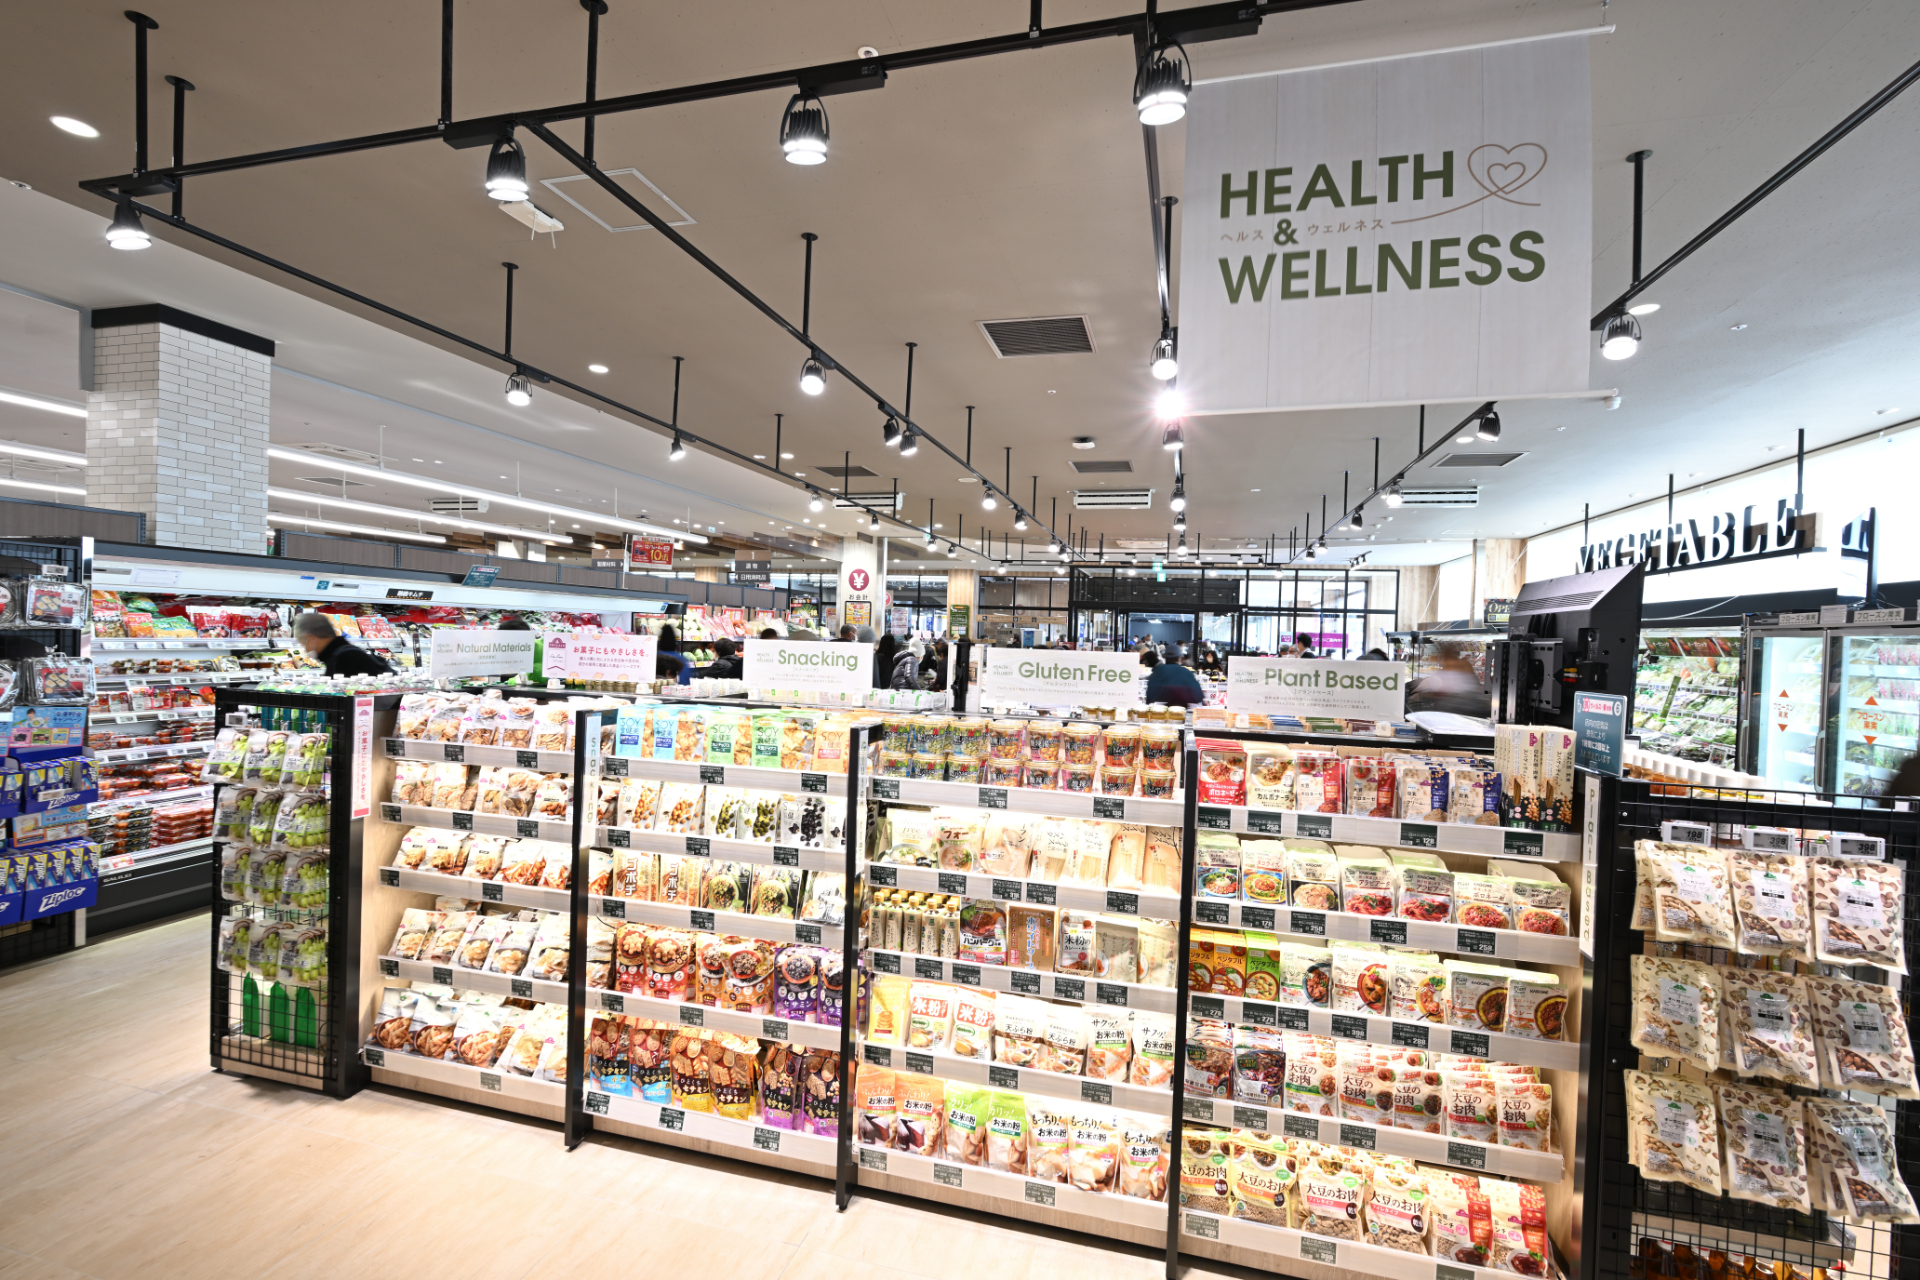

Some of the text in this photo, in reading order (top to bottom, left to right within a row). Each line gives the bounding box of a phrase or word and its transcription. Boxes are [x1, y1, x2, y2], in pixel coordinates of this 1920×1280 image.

[1220, 150, 1454, 219] HEALTH
[1220, 218, 1385, 246] ヘルス & ウェルネス
[1218, 230, 1546, 305] WELLNESS
[1857, 609, 1903, 619] フローズン果実
[456, 642, 532, 653] Natural Materials
[573, 646, 649, 657] お菓子にもやさしさを。
[778, 649, 858, 672] Snacking
[1018, 661, 1132, 683] Gluten Free
[1265, 667, 1399, 691] Plant Based
[1857, 711, 1885, 722] フローズン
[712, 724, 734, 734] SOY
[1863, 720, 1878, 730] 果実
[757, 727, 779, 737] SOY
[822, 732, 844, 742] SOY
[586, 737, 597, 824] Snacking
[1208, 788, 1235, 797] ボロネーゼ
[47, 793, 81, 810] Ziploc
[943, 830, 970, 839] フォー
[1686, 830, 1702, 839] 198
[1769, 837, 1787, 845] 398
[1858, 843, 1876, 852] 398
[1583, 788, 1596, 942] Plant Based
[1416, 885, 1451, 893] アラビアータ
[38, 886, 86, 913] Ziploc
[1473, 892, 1505, 900] ボロネーゼ
[1716, 929, 1729, 938] 150g
[1026, 915, 1036, 970] ホワイトソース
[1064, 935, 1090, 946] 米粉の
[1217, 955, 1243, 964] ベジタブル
[1250, 960, 1276, 969] ベジタブル
[649, 979, 676, 990] セサミン
[783, 1000, 812, 1009] セサミン
[913, 997, 940, 1016] 米粉
[958, 1004, 988, 1026] 米粉
[1757, 1008, 1783, 1016] オーガニック
[1005, 1024, 1034, 1035] 天ぷら粉
[1096, 1030, 1125, 1039] お米の粉
[1048, 1033, 1076, 1047] 天ぷら粉
[1144, 1040, 1173, 1051] お米の粉
[1694, 1052, 1708, 1061] 150g
[1288, 1063, 1317, 1075] 大豆の
[1288, 1073, 1311, 1086] お肉
[1343, 1075, 1374, 1089] 大豆の
[682, 1085, 709, 1094] セサミン
[716, 1087, 738, 1096] ひとくち
[898, 1090, 930, 1100] ふんわり!
[1343, 1086, 1367, 1099] お肉
[718, 1094, 746, 1104] セサミン
[868, 1096, 895, 1105] お米の粉
[1452, 1093, 1482, 1105] 大豆の
[904, 1099, 933, 1111] お米の粉
[1452, 1103, 1476, 1117] お肉
[1502, 1100, 1531, 1111] 大豆の
[950, 1109, 976, 1125] お米の粉
[1032, 1113, 1062, 1126] もっちり!
[1503, 1110, 1527, 1123] お肉
[992, 1117, 1021, 1131] お米の粉
[1070, 1115, 1102, 1130] もっちり!
[1037, 1127, 1066, 1138] お米の粉
[1076, 1130, 1107, 1142] お米の粉
[1130, 1146, 1159, 1157] お米の粉
[1238, 1171, 1289, 1193] 大豆のお肉
[1306, 1182, 1358, 1201] 大豆のお肉
[1308, 1195, 1334, 1206] フィレタイプ
[1370, 1190, 1425, 1215] 大豆のお肉
[1372, 1203, 1399, 1216] フィレタイプ
[1438, 1219, 1454, 1229] ミンチ
